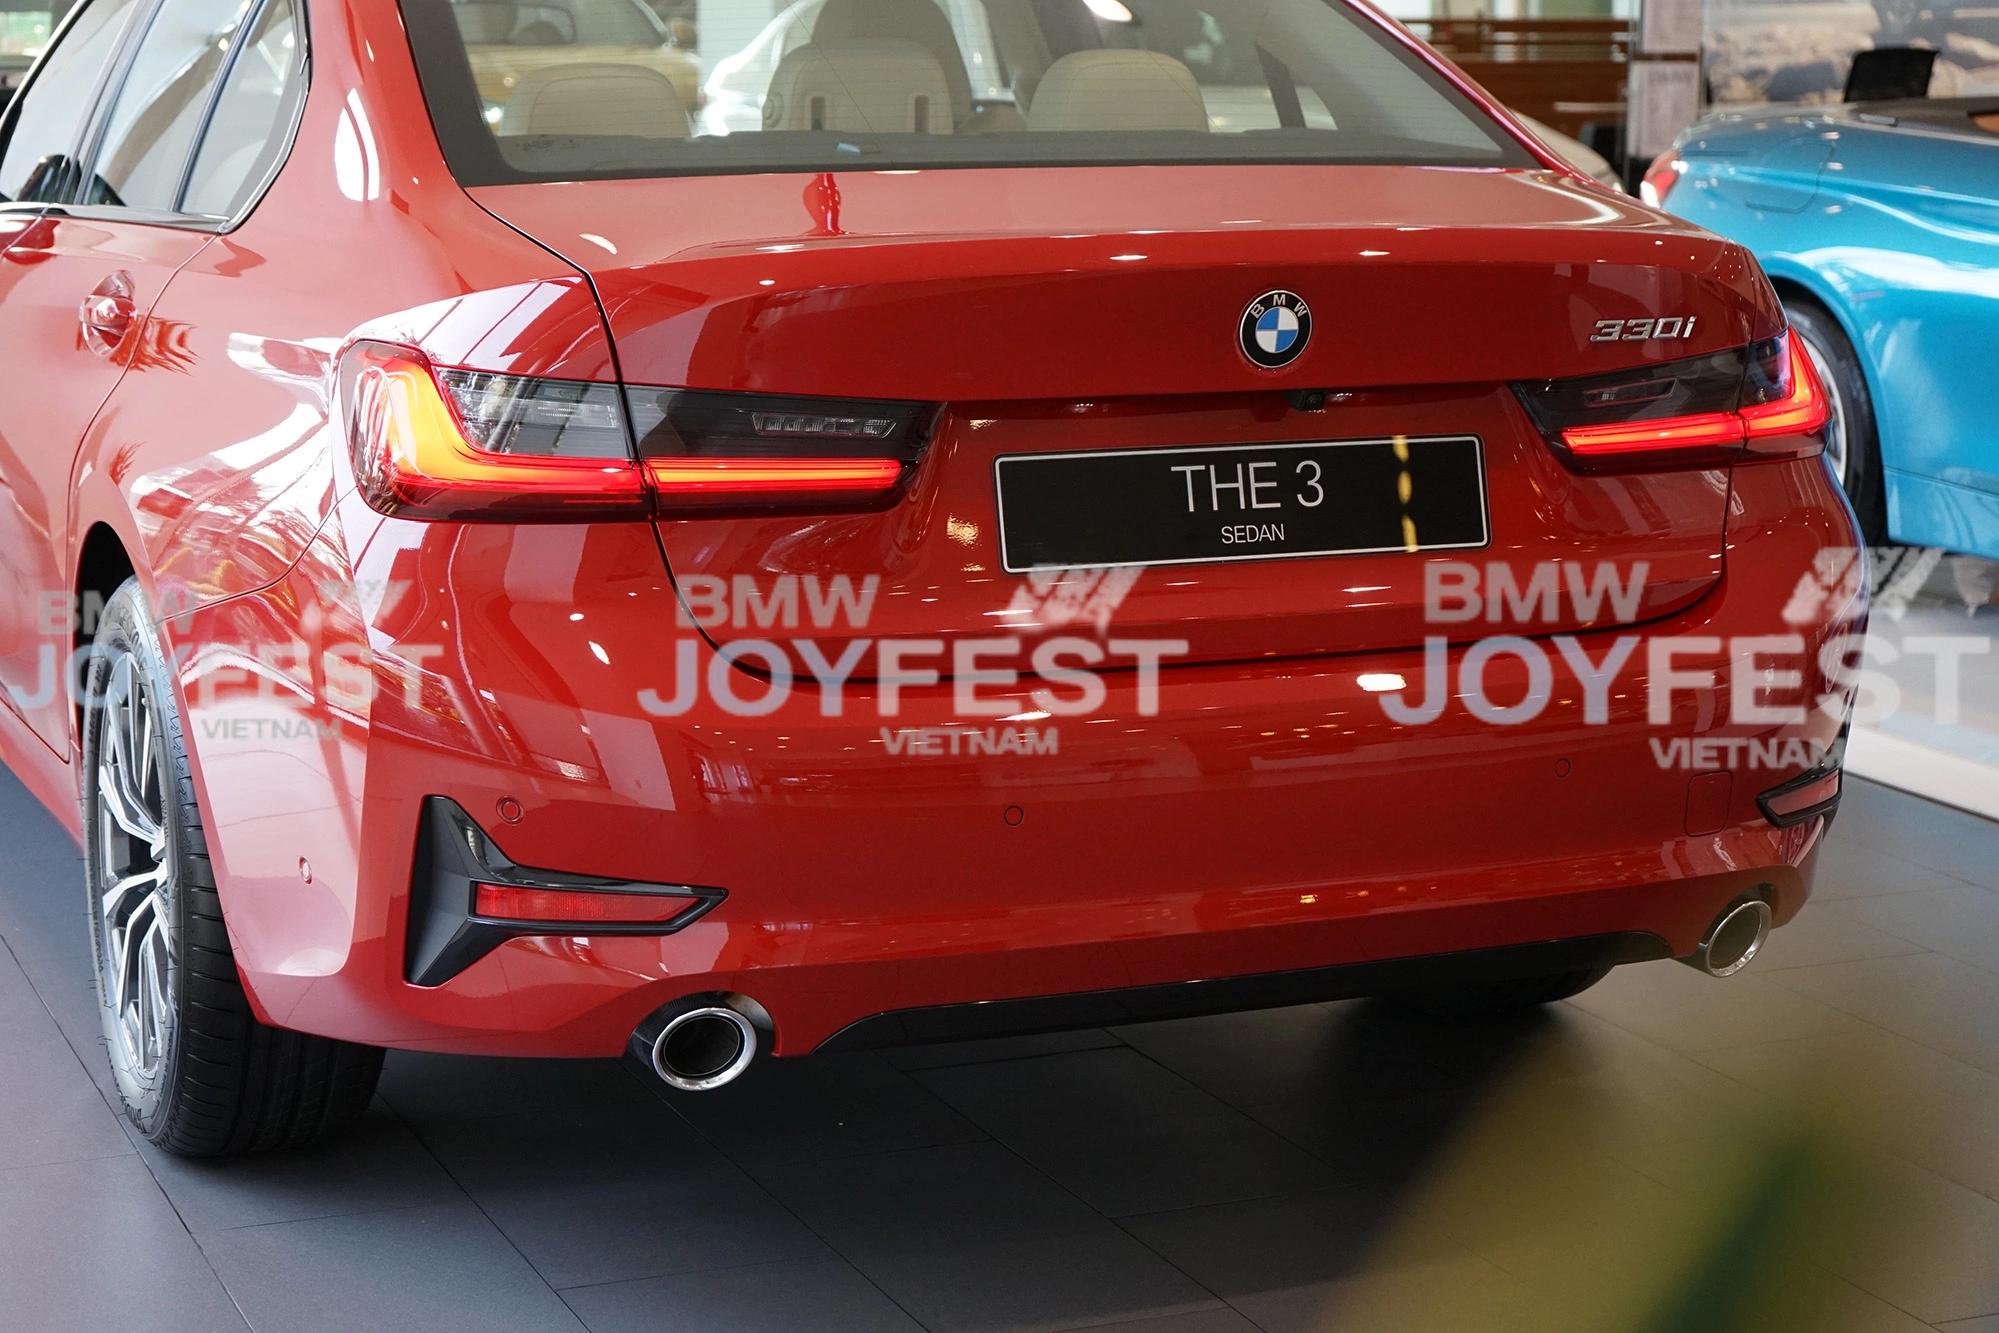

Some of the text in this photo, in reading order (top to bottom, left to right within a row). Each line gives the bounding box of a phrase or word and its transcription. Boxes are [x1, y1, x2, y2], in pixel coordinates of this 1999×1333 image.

[1250, 294, 1307, 318] BMW
[1590, 316, 1697, 341] 330i
[1170, 460, 1324, 512] THE 3
[1221, 524, 1285, 544] SEDAN
[675, 574, 880, 629] BMW
[1424, 562, 1650, 624] BMW
[8, 644, 443, 709] JOYFEST
[637, 638, 1189, 717] JOYFEST
[1379, 635, 1991, 726] JOYFEST
[201, 718, 343, 741] VIETNAM
[880, 727, 1059, 756] VIETNAM
[1650, 737, 1846, 770] VIETNAM
